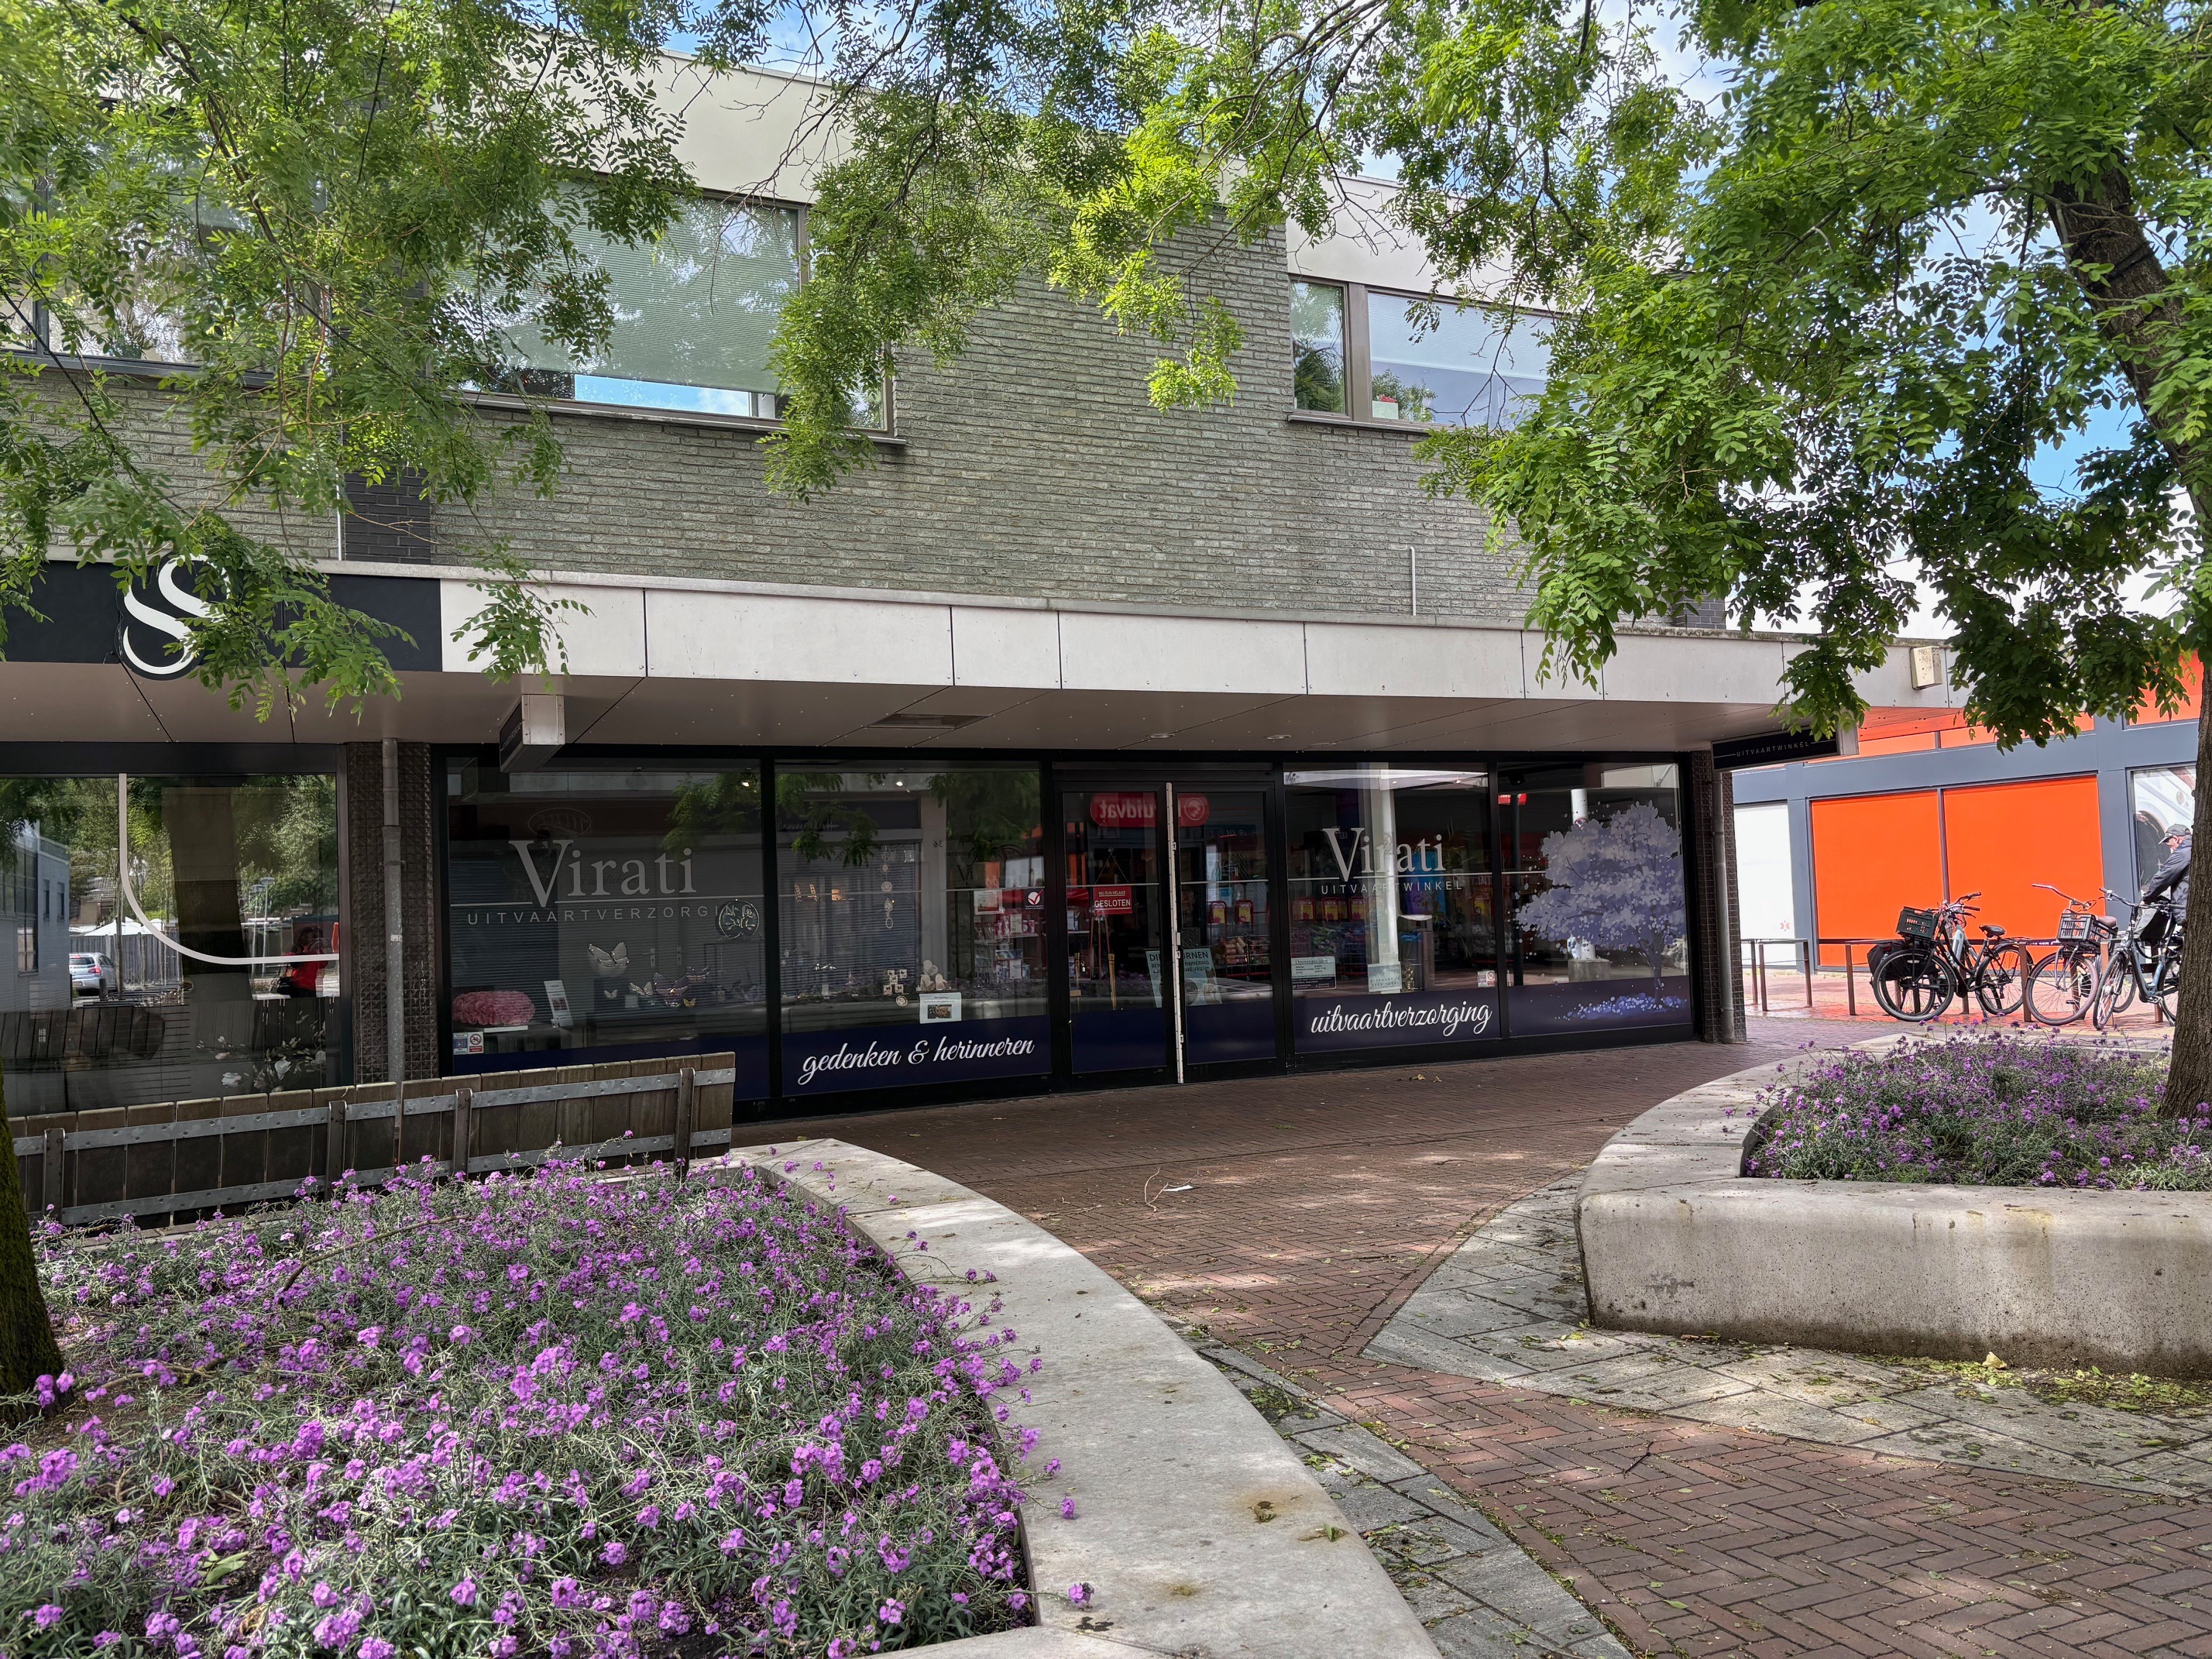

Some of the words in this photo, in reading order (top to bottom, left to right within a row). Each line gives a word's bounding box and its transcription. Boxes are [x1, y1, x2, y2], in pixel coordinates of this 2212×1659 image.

[1736, 741, 1809, 757] UITVAARTWINKEL
[508, 840, 696, 908] Virati
[1321, 827, 1447, 882] Virati
[1094, 898, 1131, 908] GESLOTEN
[1310, 1001, 1492, 1037] uitvaartverzorging
[798, 1042, 902, 1085] gedenken
[908, 1039, 929, 1065] &
[933, 1036, 1035, 1062] herinneren
